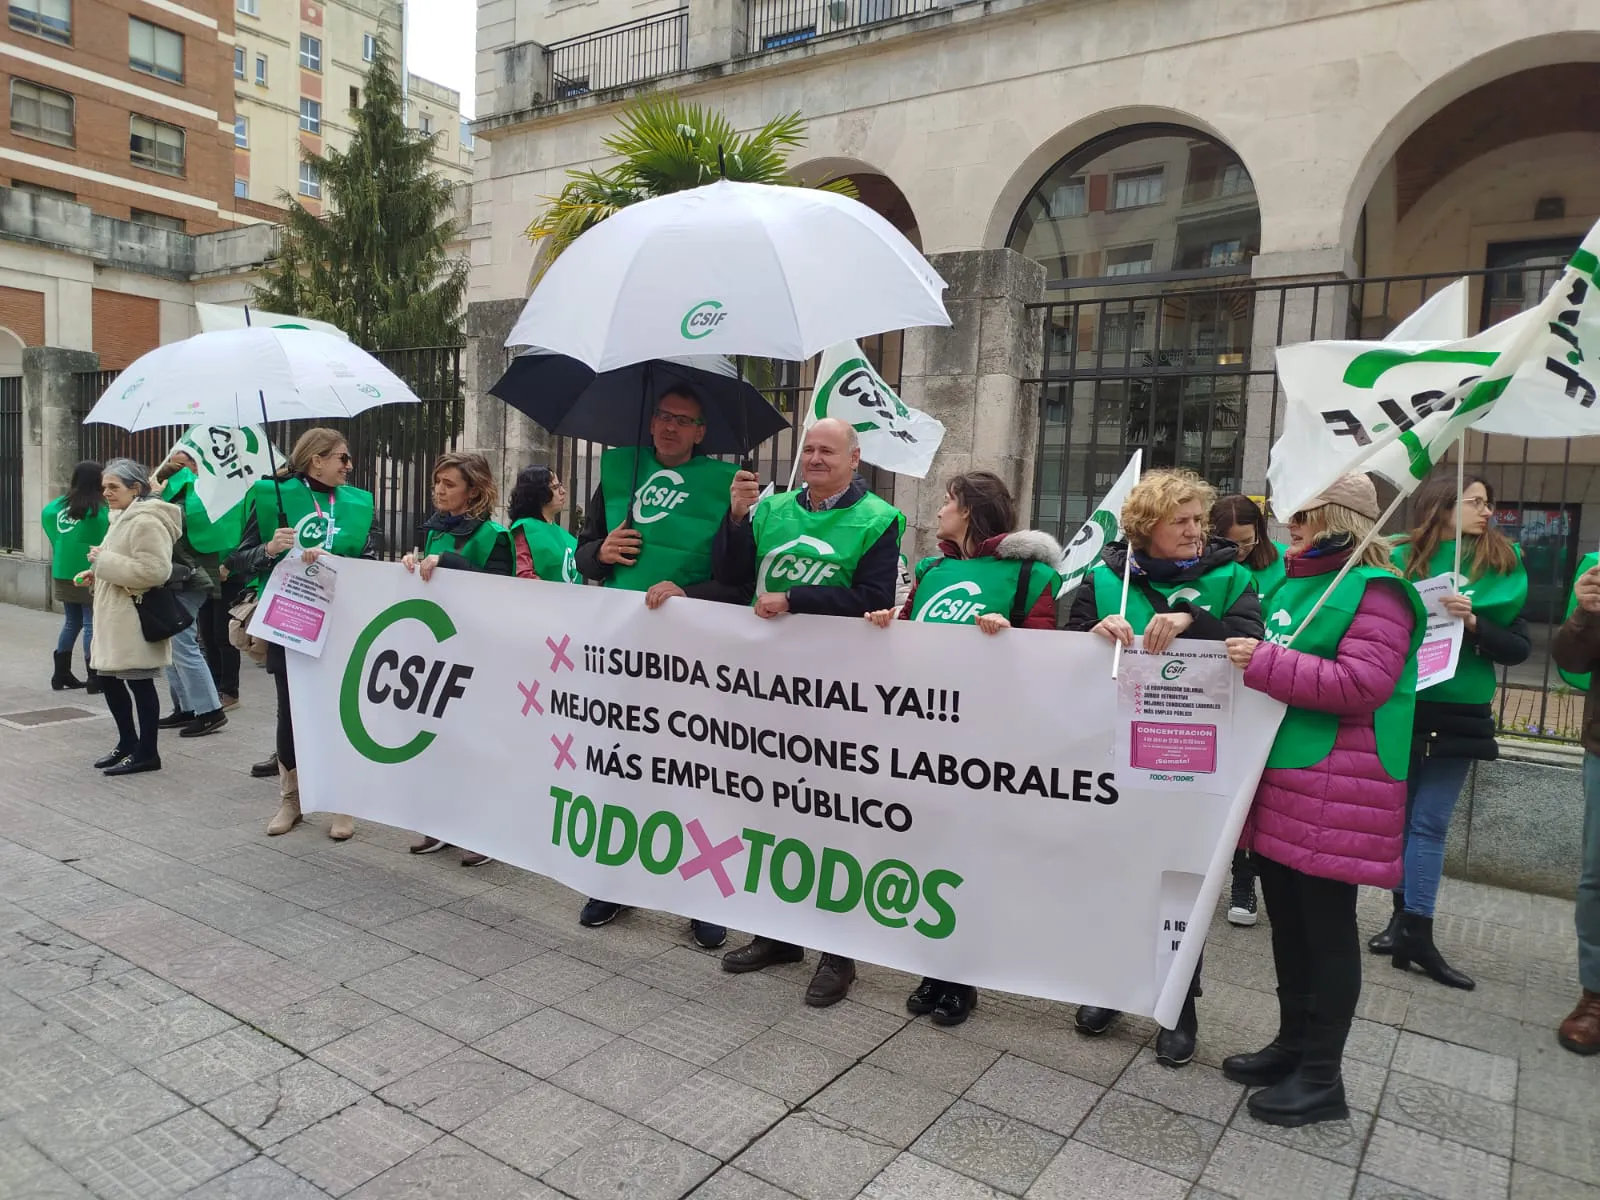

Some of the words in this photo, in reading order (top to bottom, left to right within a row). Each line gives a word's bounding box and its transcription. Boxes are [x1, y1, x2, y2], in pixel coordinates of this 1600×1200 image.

[690, 312, 728, 326] CSIF
[642, 485, 690, 510] CSIF
[771, 554, 840, 585] CSIF
[929, 598, 986, 622] CSIF
[367, 649, 475, 718] CSIF
[716, 665, 868, 713] SALARIAL
[876, 684, 961, 723] YA!!!
[1138, 727, 1212, 736] CONCENTRACIÓN
[550, 689, 660, 734] MEJORES
[668, 711, 880, 775] CONDICIONES
[891, 748, 1119, 806] LABORALES
[586, 743, 642, 781] MÁS
[651, 757, 764, 803] EMPLEO
[773, 777, 913, 833] PÚBLICO
[1164, 920, 1171, 930] A
